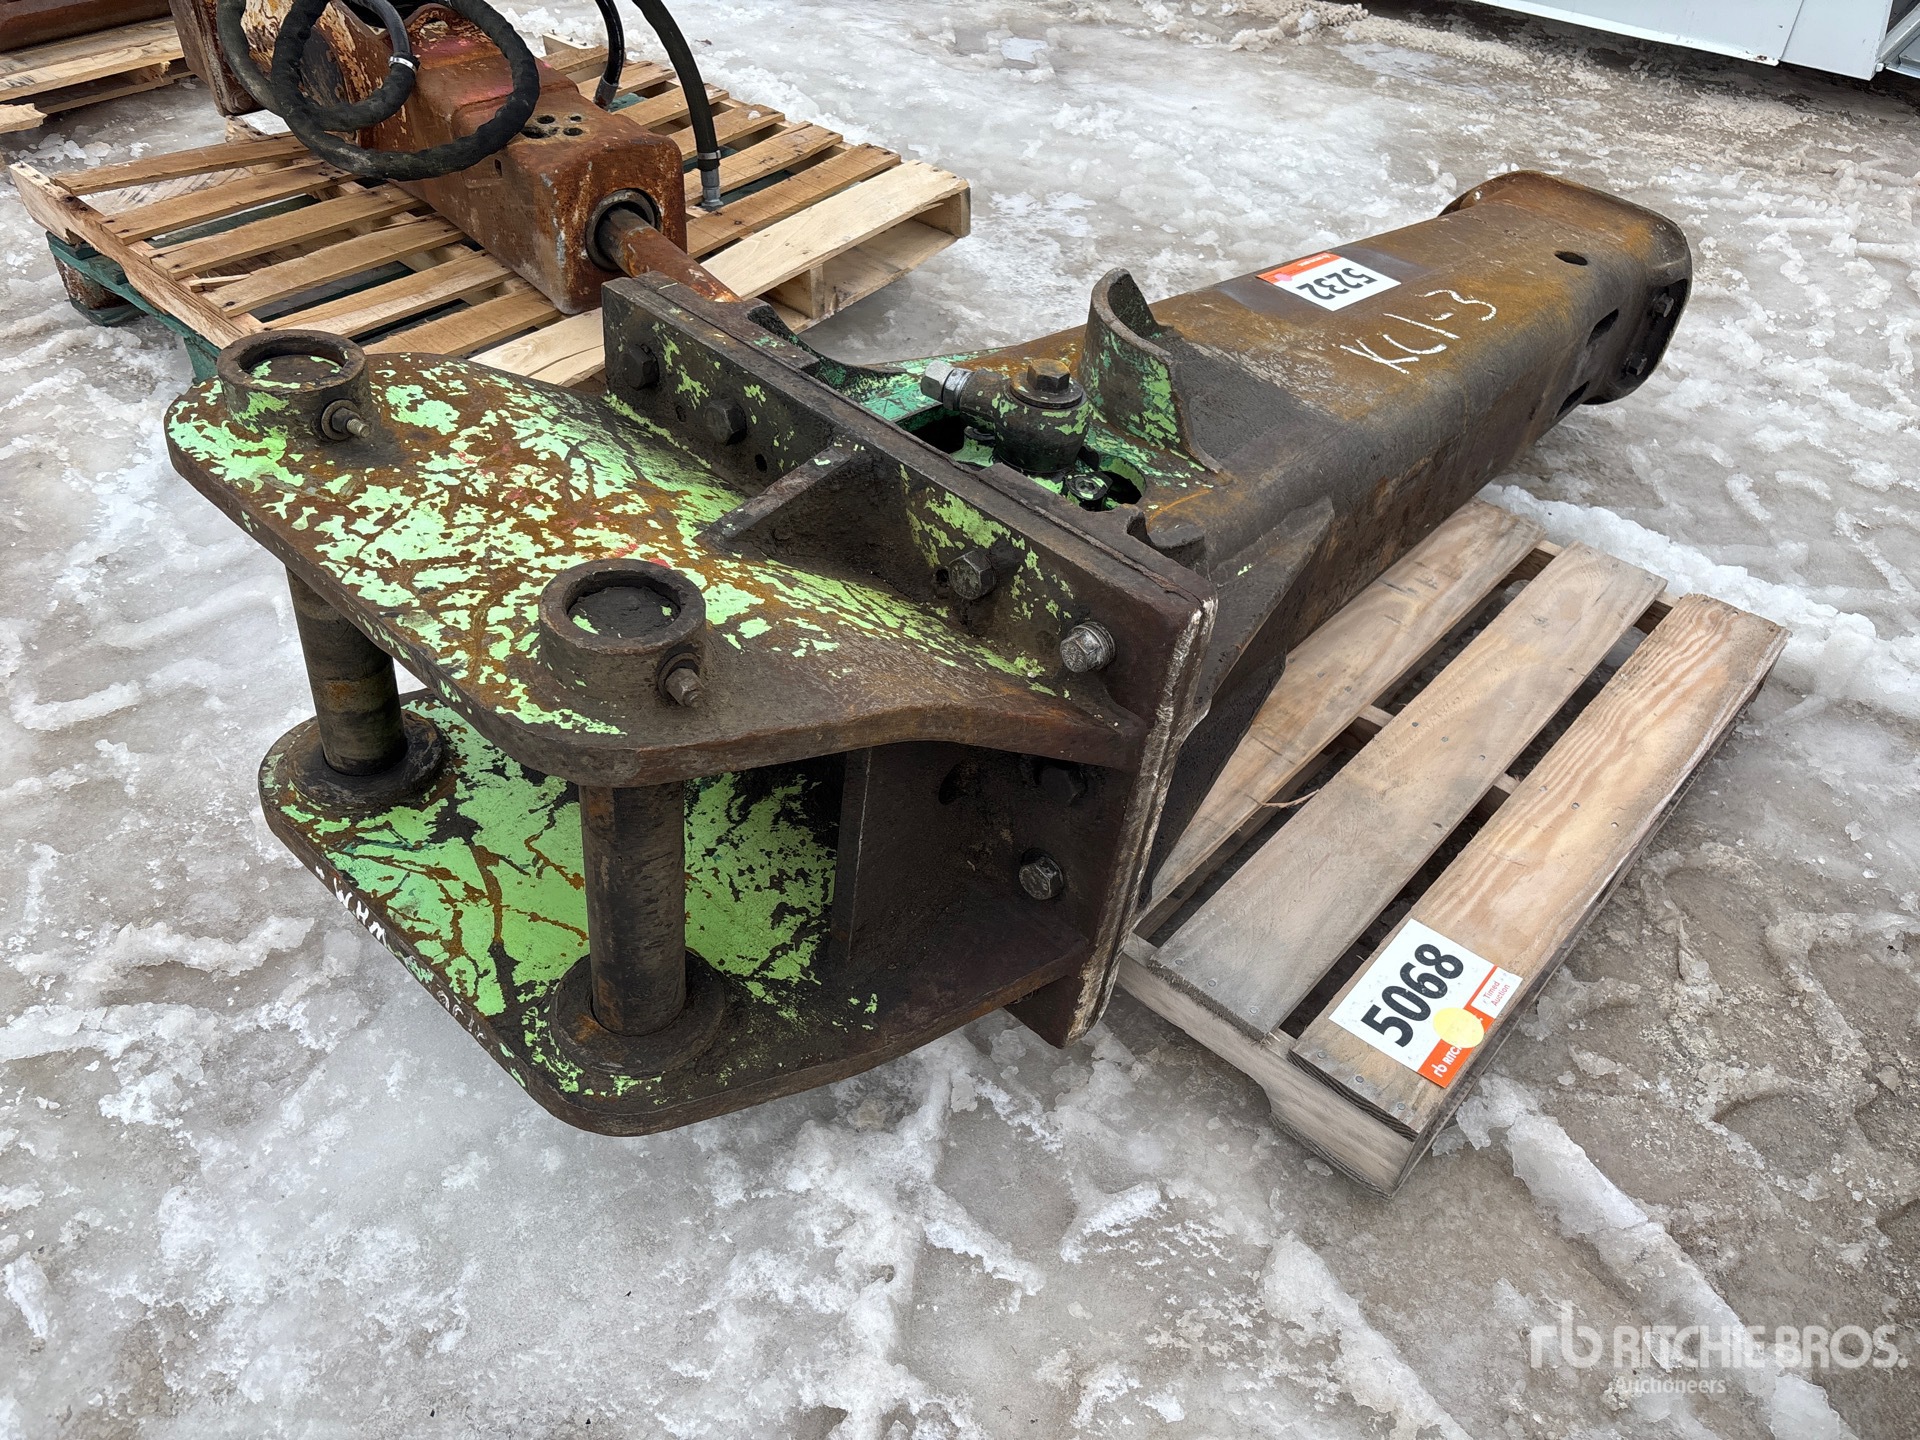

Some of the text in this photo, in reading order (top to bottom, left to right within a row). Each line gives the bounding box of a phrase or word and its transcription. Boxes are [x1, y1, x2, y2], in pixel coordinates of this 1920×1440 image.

[1296, 267, 1378, 301] 5232
[1360, 943, 1464, 1048] 5068
[1483, 980, 1501, 1001] Timed
[1491, 983, 1511, 1007] Auction
